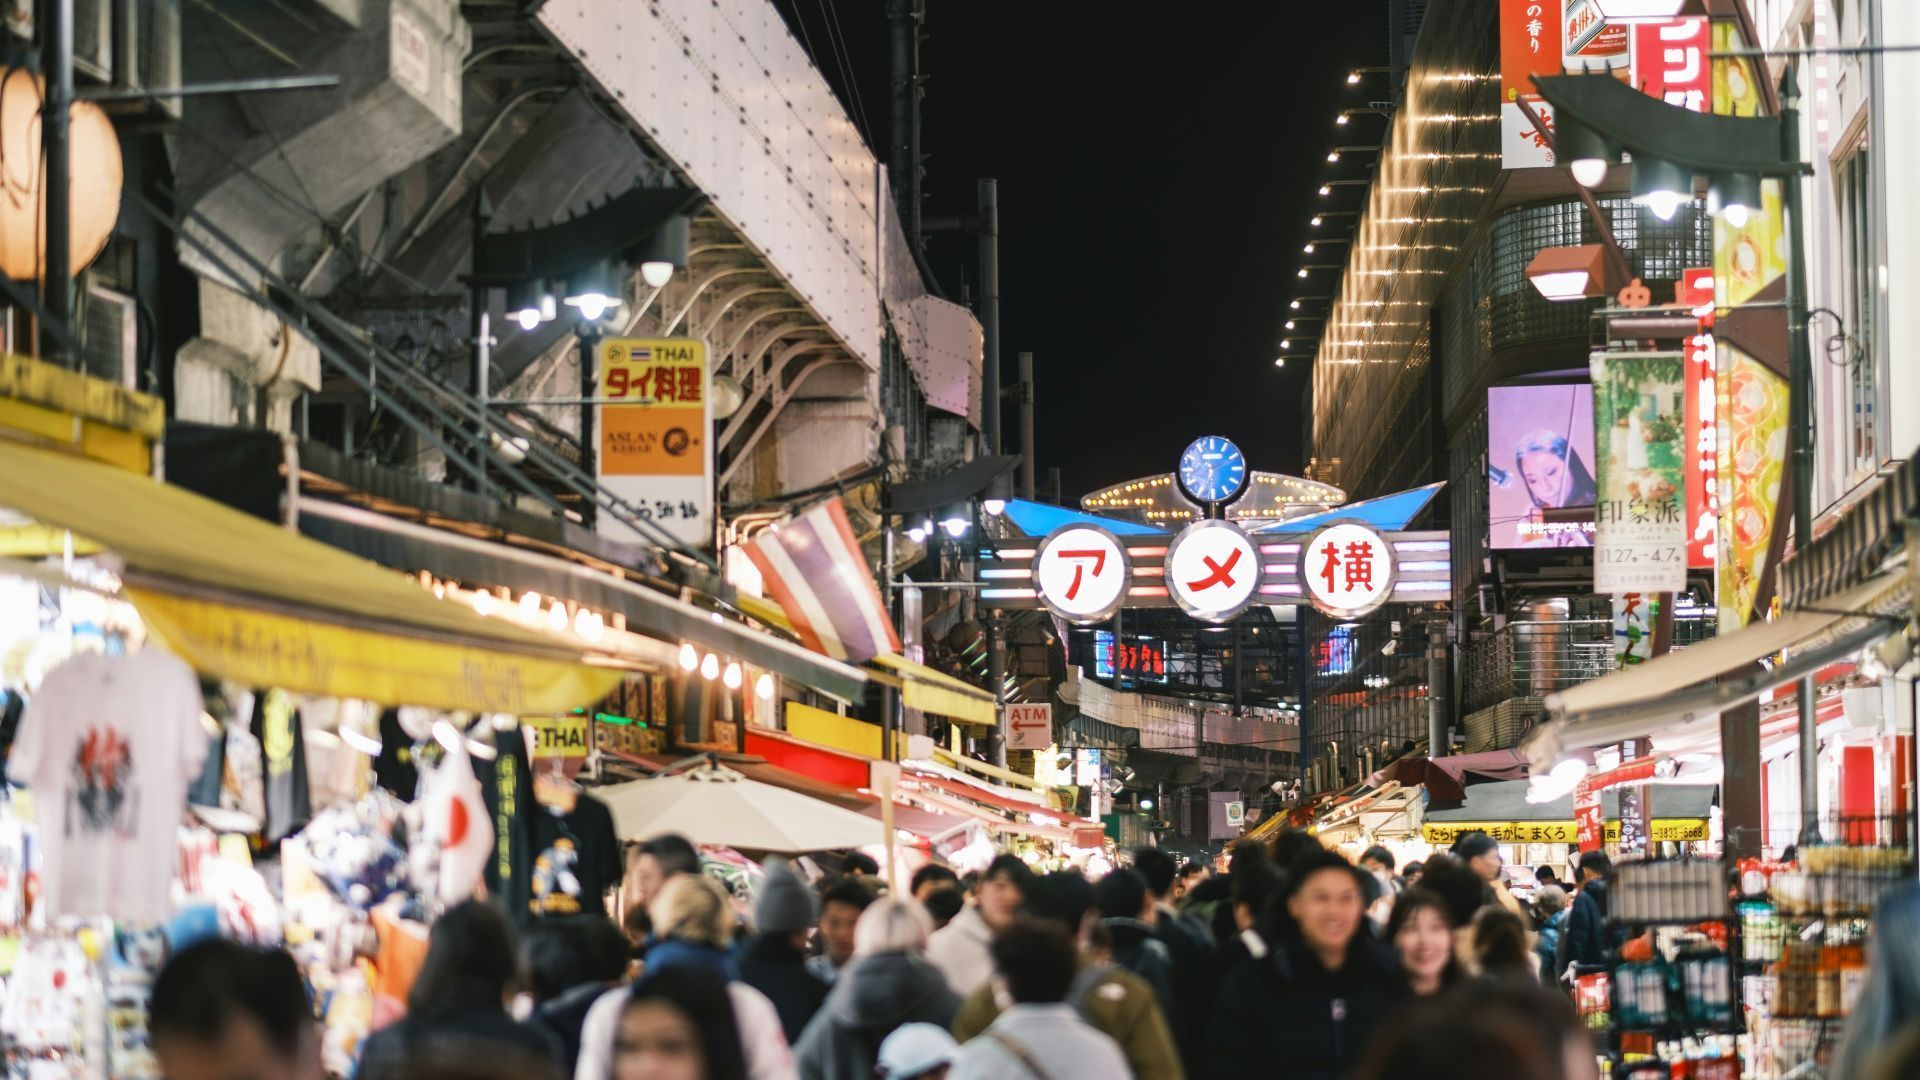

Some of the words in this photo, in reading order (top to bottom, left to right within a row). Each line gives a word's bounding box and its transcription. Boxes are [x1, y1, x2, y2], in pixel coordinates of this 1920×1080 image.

[1526, 0, 1543, 54] の香り
[655, 347, 694, 360] THAI
[607, 367, 701, 402] タイ料理
[1598, 499, 1680, 524] 印象派
[1057, 540, 1374, 601] アメ横
[1011, 708, 1047, 721] ATM
[1491, 826, 1525, 841] 毛がに
[1531, 826, 1566, 840] まぐろ
